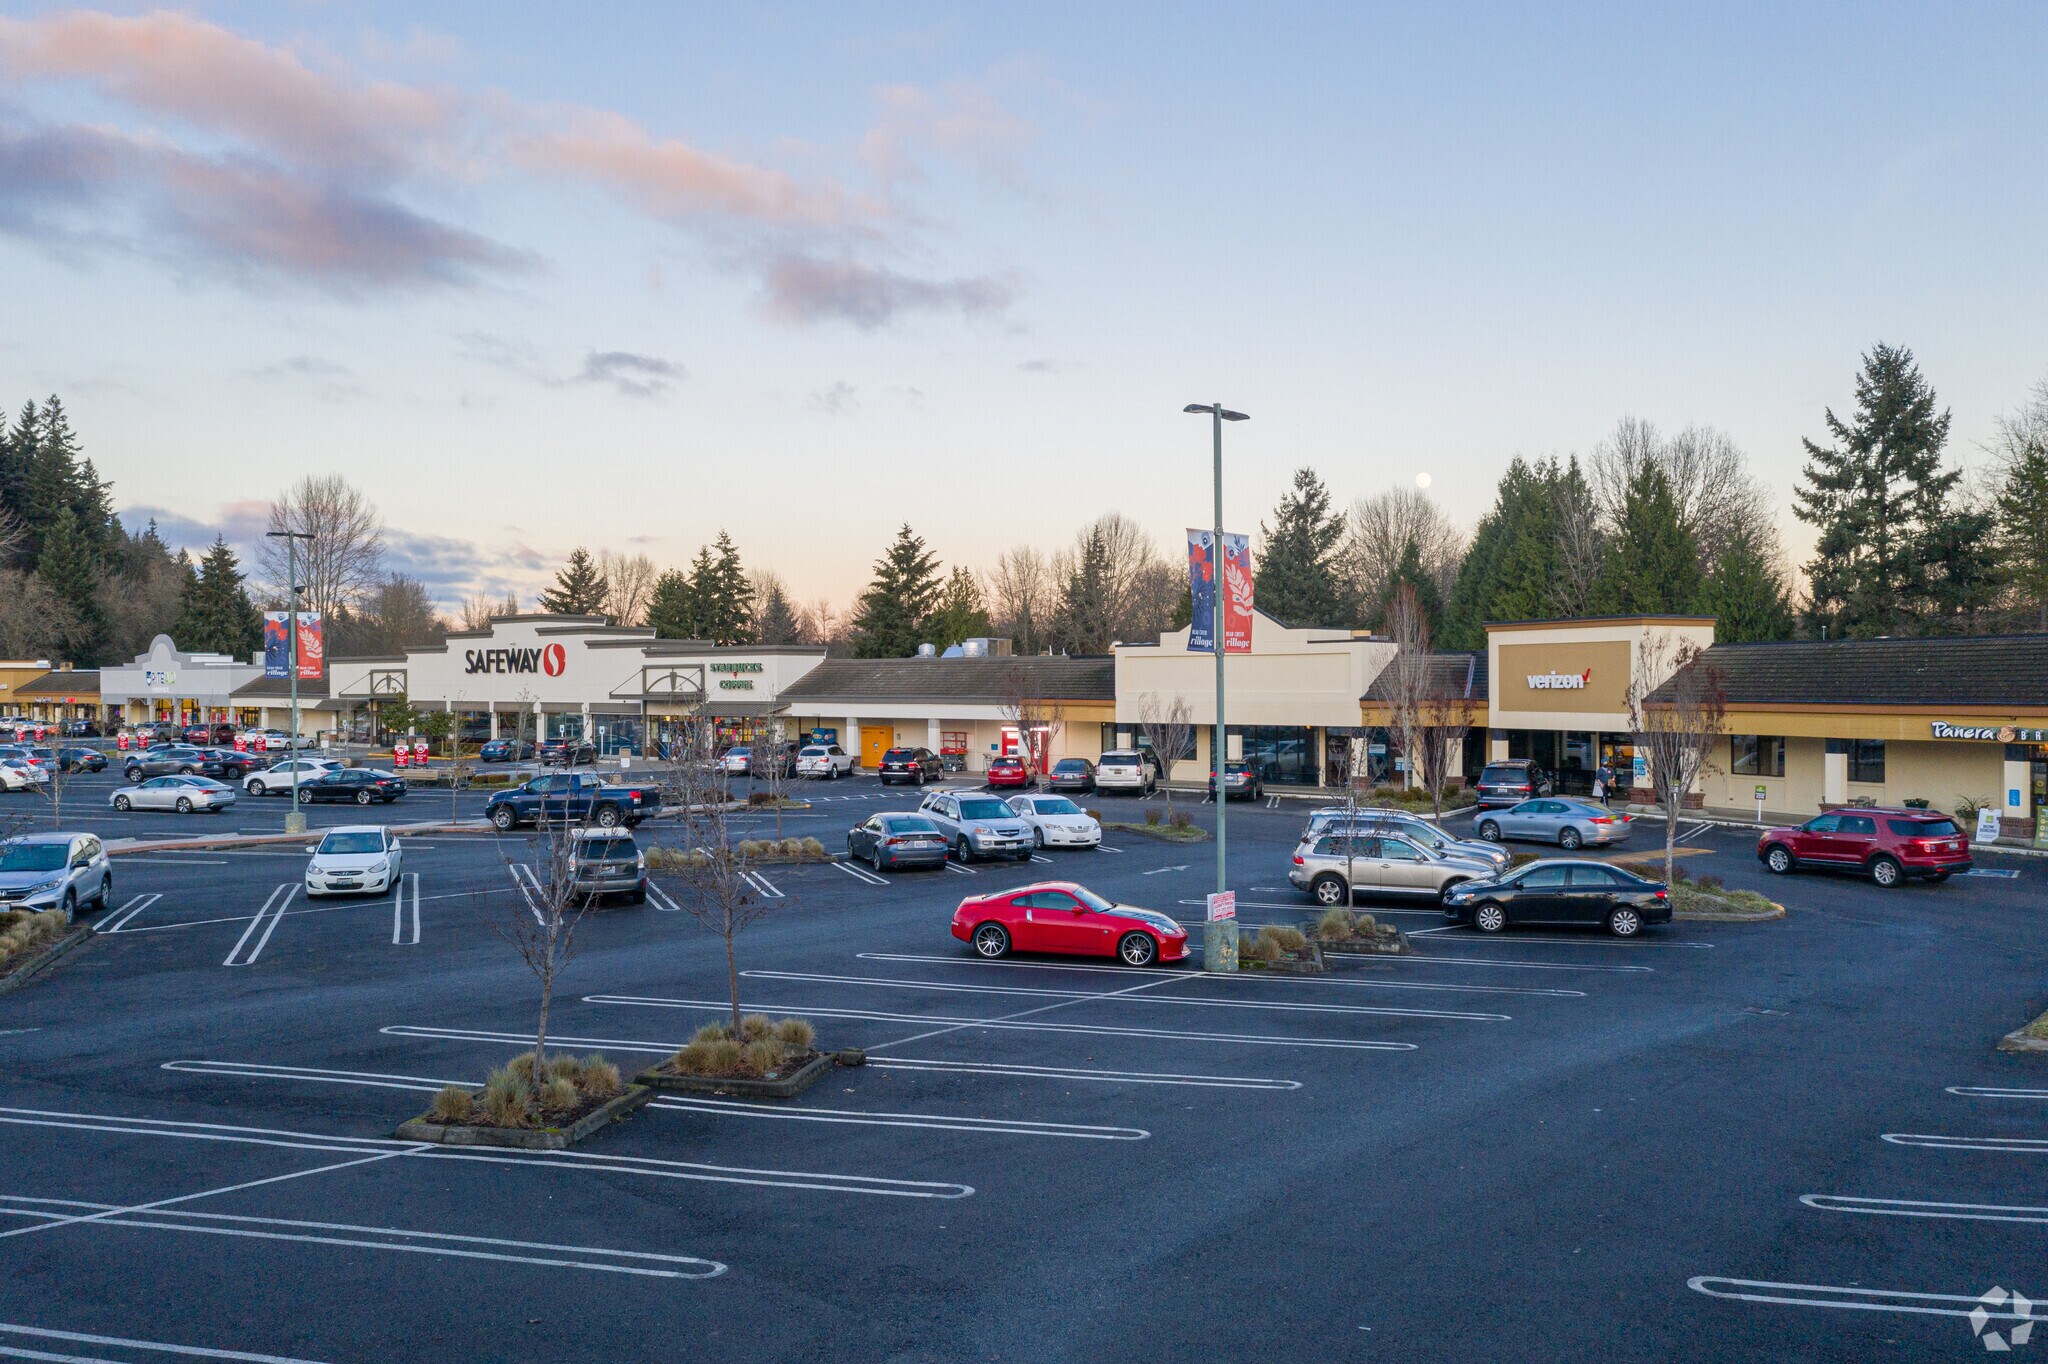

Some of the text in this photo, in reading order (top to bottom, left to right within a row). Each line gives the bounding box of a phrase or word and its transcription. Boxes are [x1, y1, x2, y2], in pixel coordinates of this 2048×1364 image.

[465, 647, 542, 674] SAFEWAY
[709, 662, 764, 673] STARBUCKS
[719, 679, 754, 690] COFFEE
[1526, 670, 1584, 689] verizon
[1930, 720, 1995, 740] Panera
